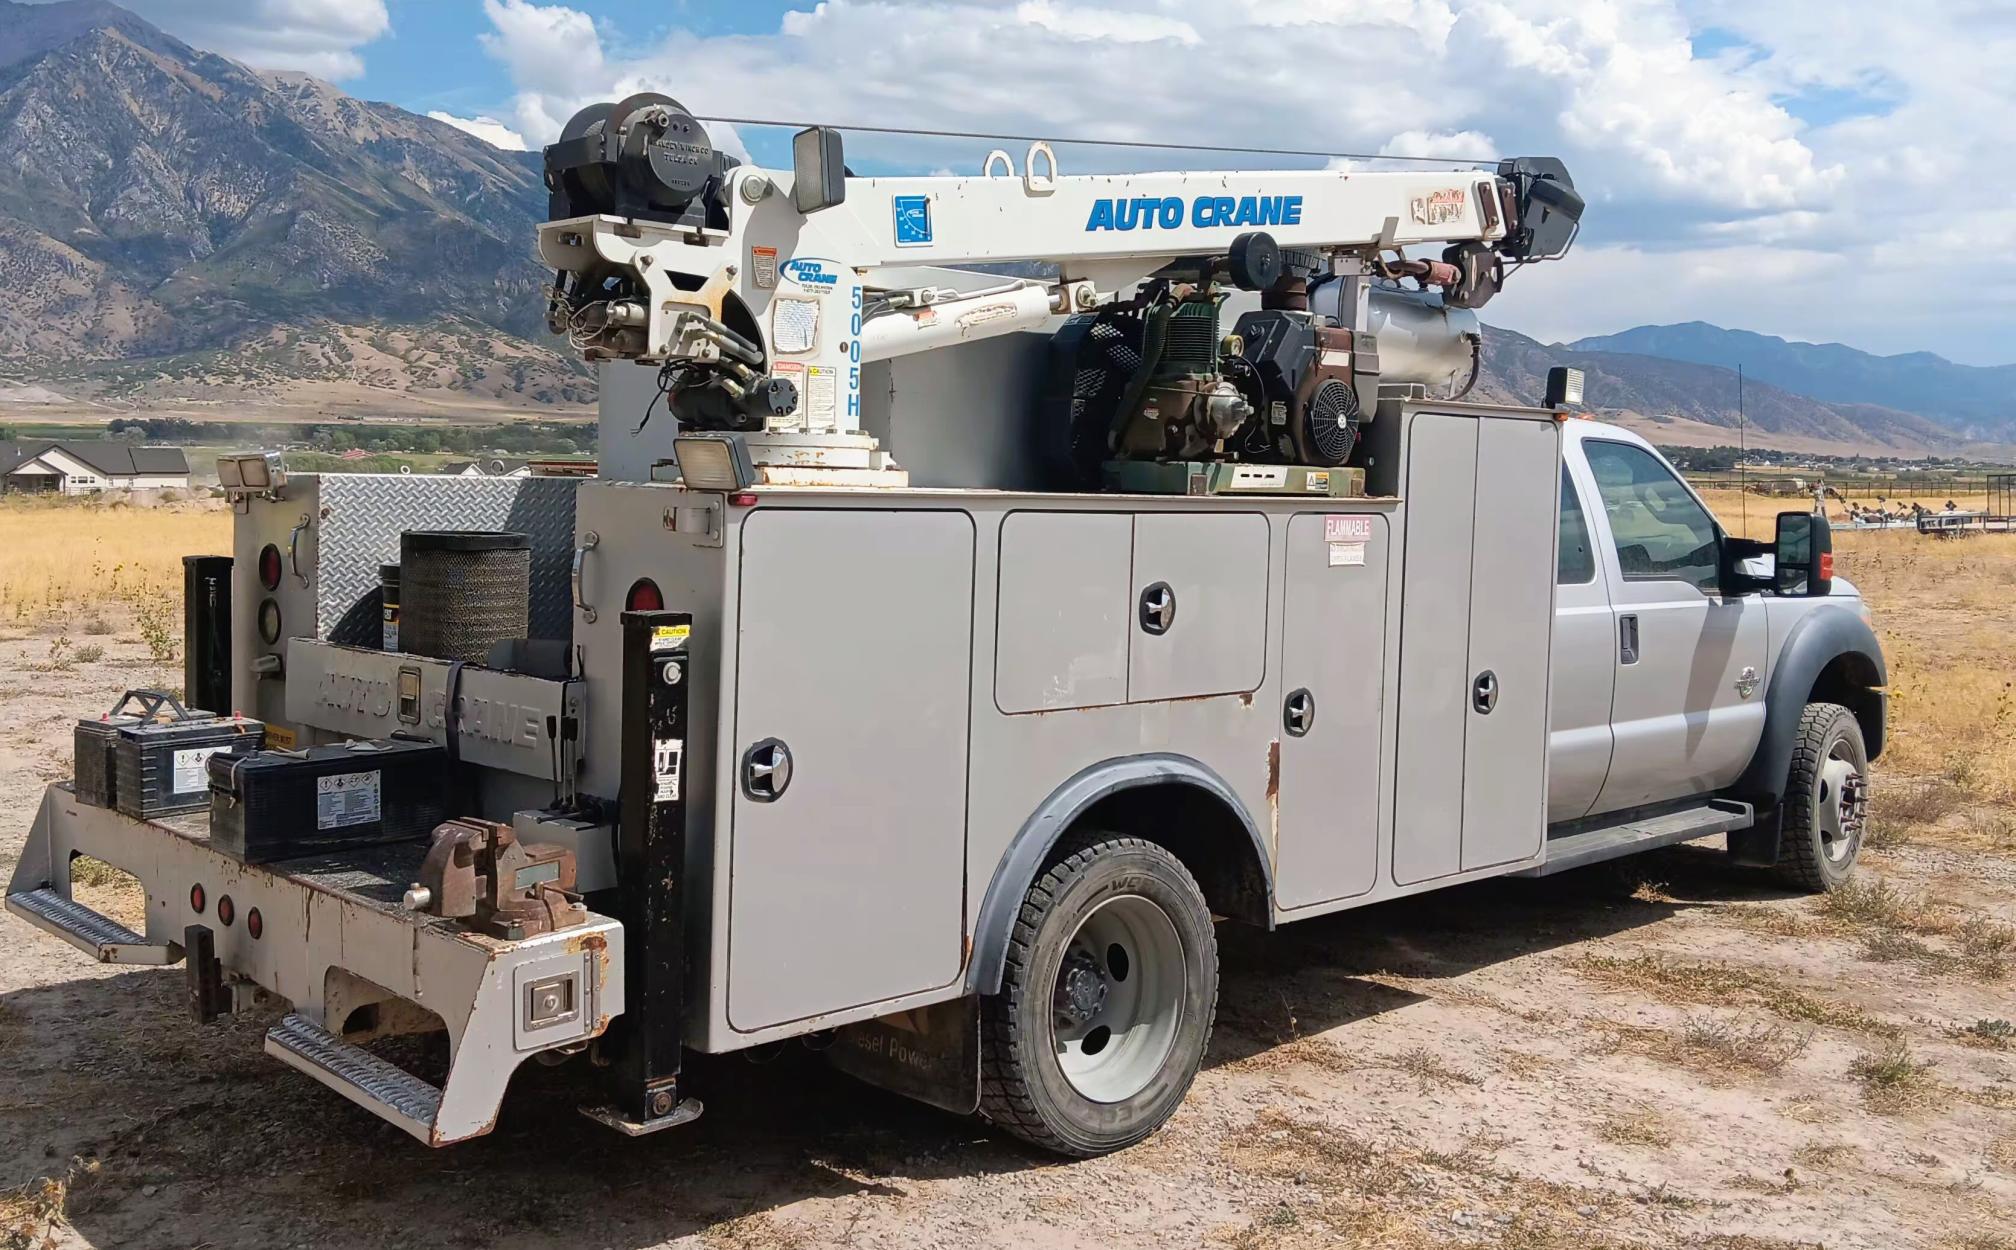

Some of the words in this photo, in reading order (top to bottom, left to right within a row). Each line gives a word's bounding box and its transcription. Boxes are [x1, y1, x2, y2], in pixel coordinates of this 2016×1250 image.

[1085, 196, 1185, 231] AUTO
[1191, 195, 1303, 228] CRANE
[789, 260, 822, 273] AUTO
[798, 272, 838, 285] CRANE
[1327, 519, 1370, 536] FLAMMABLE
